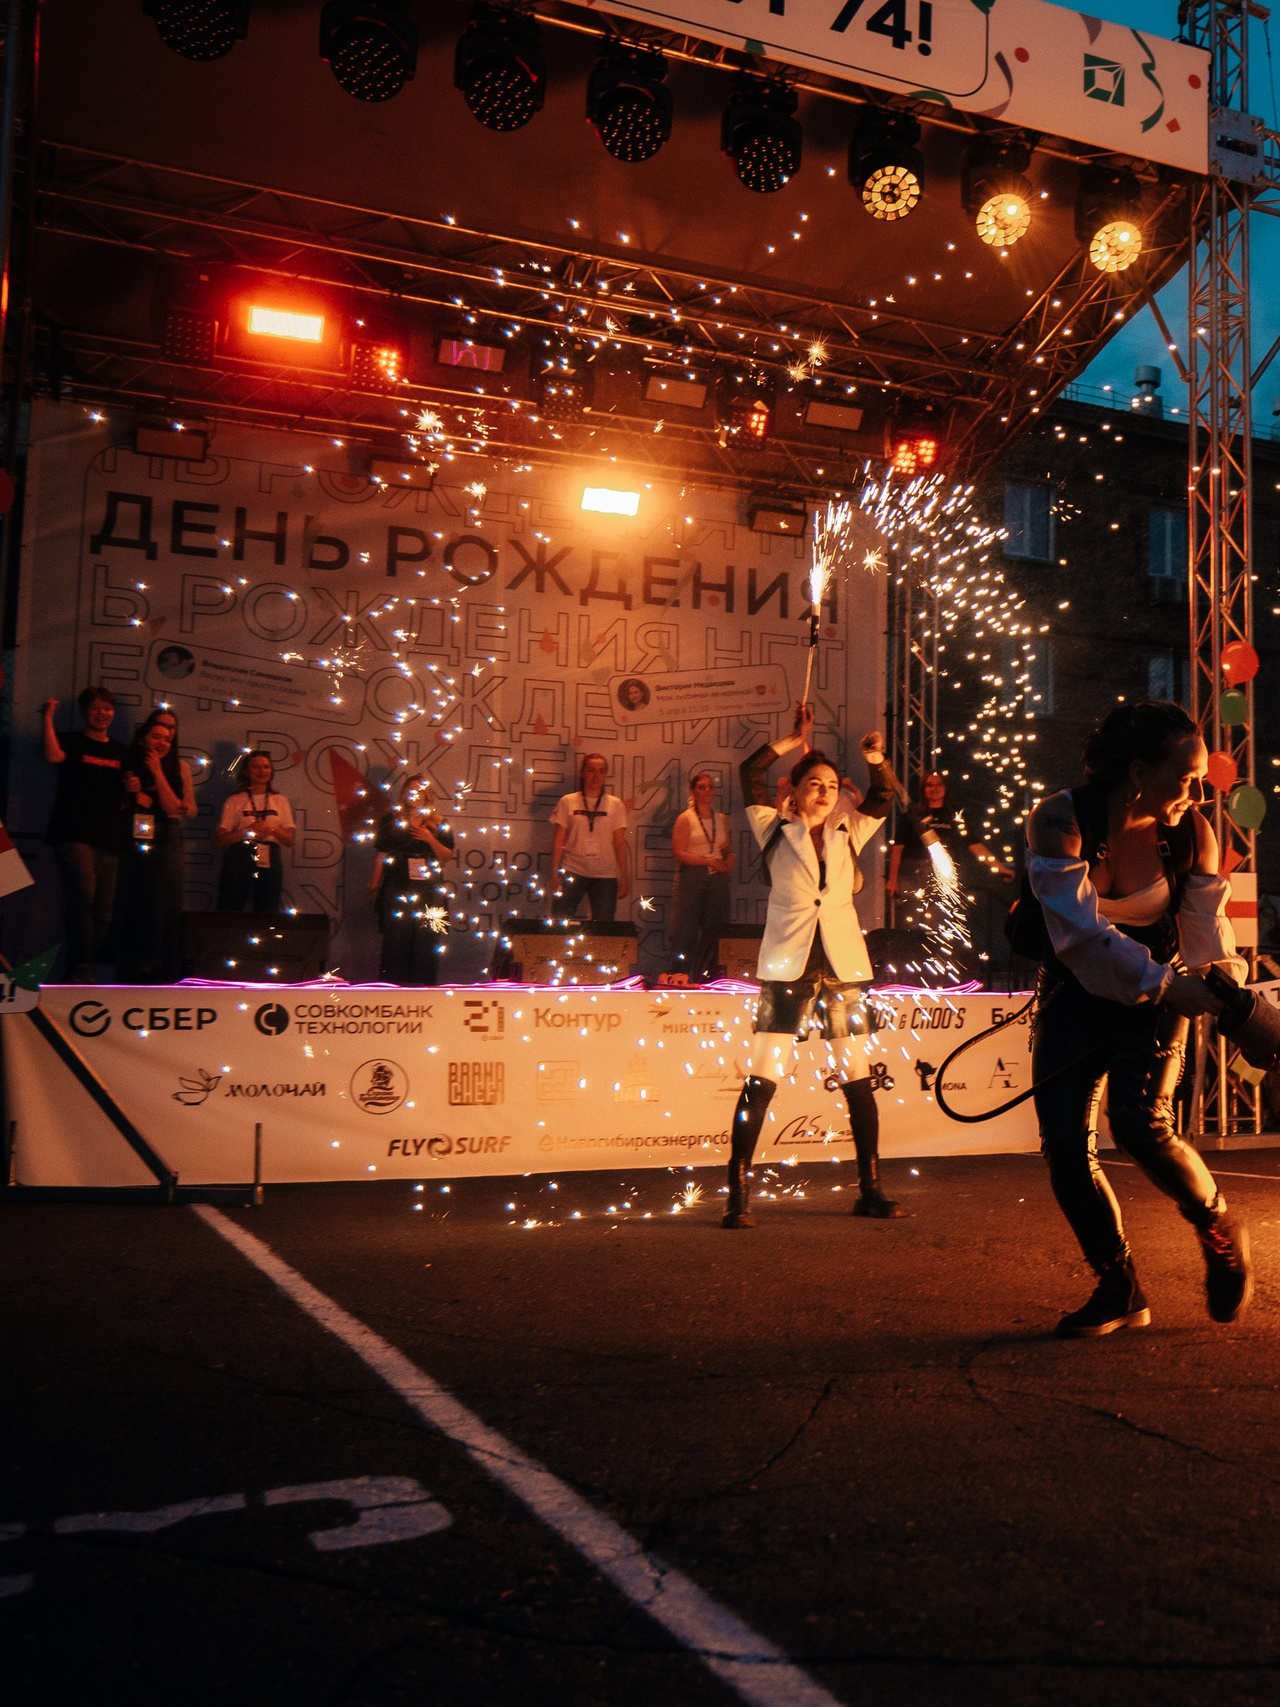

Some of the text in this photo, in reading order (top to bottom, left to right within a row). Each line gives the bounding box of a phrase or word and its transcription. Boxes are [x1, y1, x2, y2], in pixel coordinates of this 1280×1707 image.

[89, 491, 838, 624] ДЕНЬ РОЖДЕНИЯ
[180, 574, 679, 673] РОЖДЕНИЯ
[123, 1007, 217, 1030] СБЕР
[294, 1004, 433, 1018] СОВКОМБАНК
[463, 1000, 505, 1032] 21
[533, 1007, 622, 1032] Контур
[294, 1021, 423, 1034] ТЕХНОЛОГИИ
[225, 1081, 326, 1098] МОЛОЧАЙ
